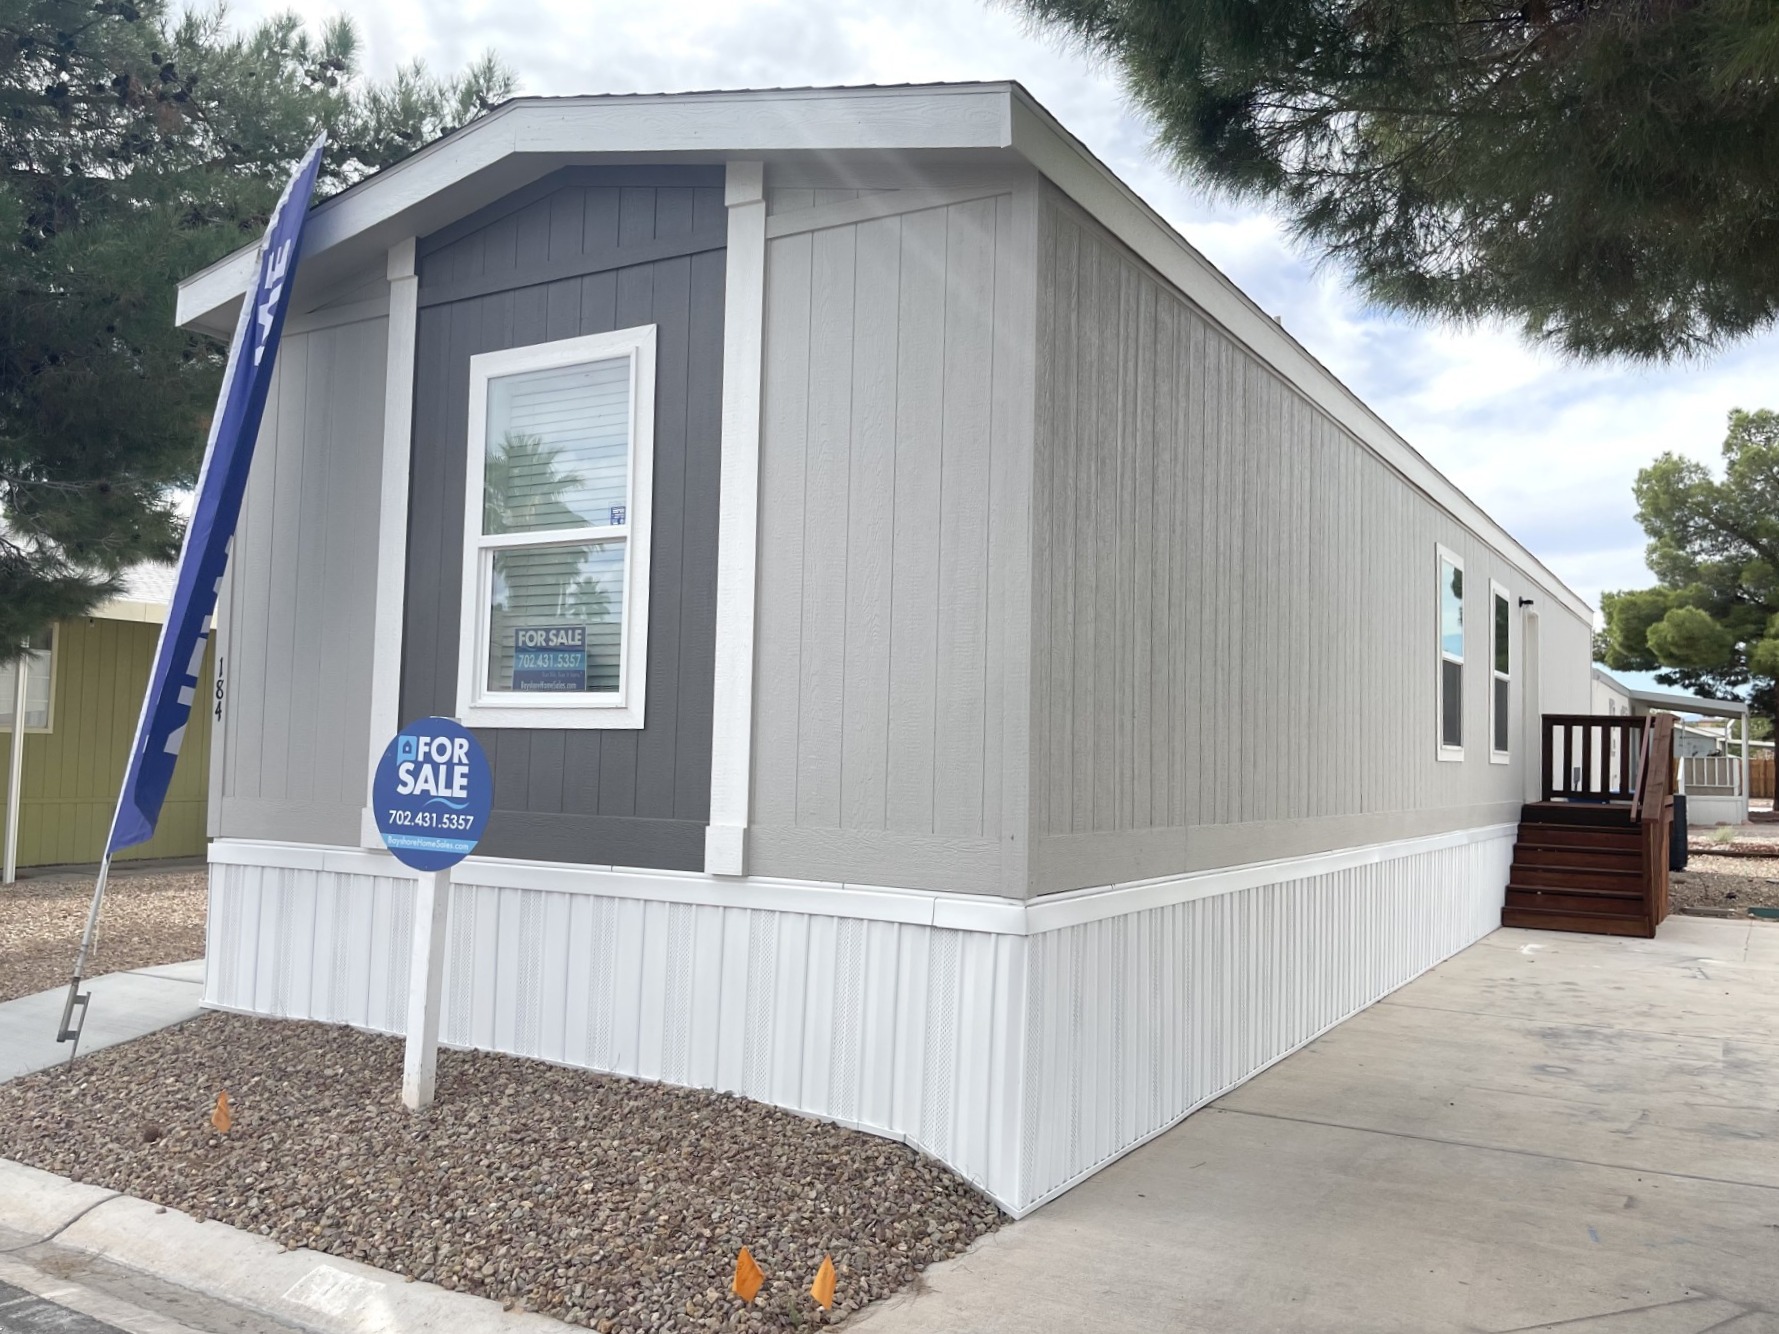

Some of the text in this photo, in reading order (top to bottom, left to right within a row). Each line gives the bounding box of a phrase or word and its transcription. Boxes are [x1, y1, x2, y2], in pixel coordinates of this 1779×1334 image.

[518, 629, 582, 646] FOR SALE
[518, 653, 582, 668] 702.431.5357
[214, 656, 224, 722] 184
[418, 736, 469, 764] FOR
[396, 761, 470, 798] SALE
[388, 809, 474, 830] 702.431.5357
